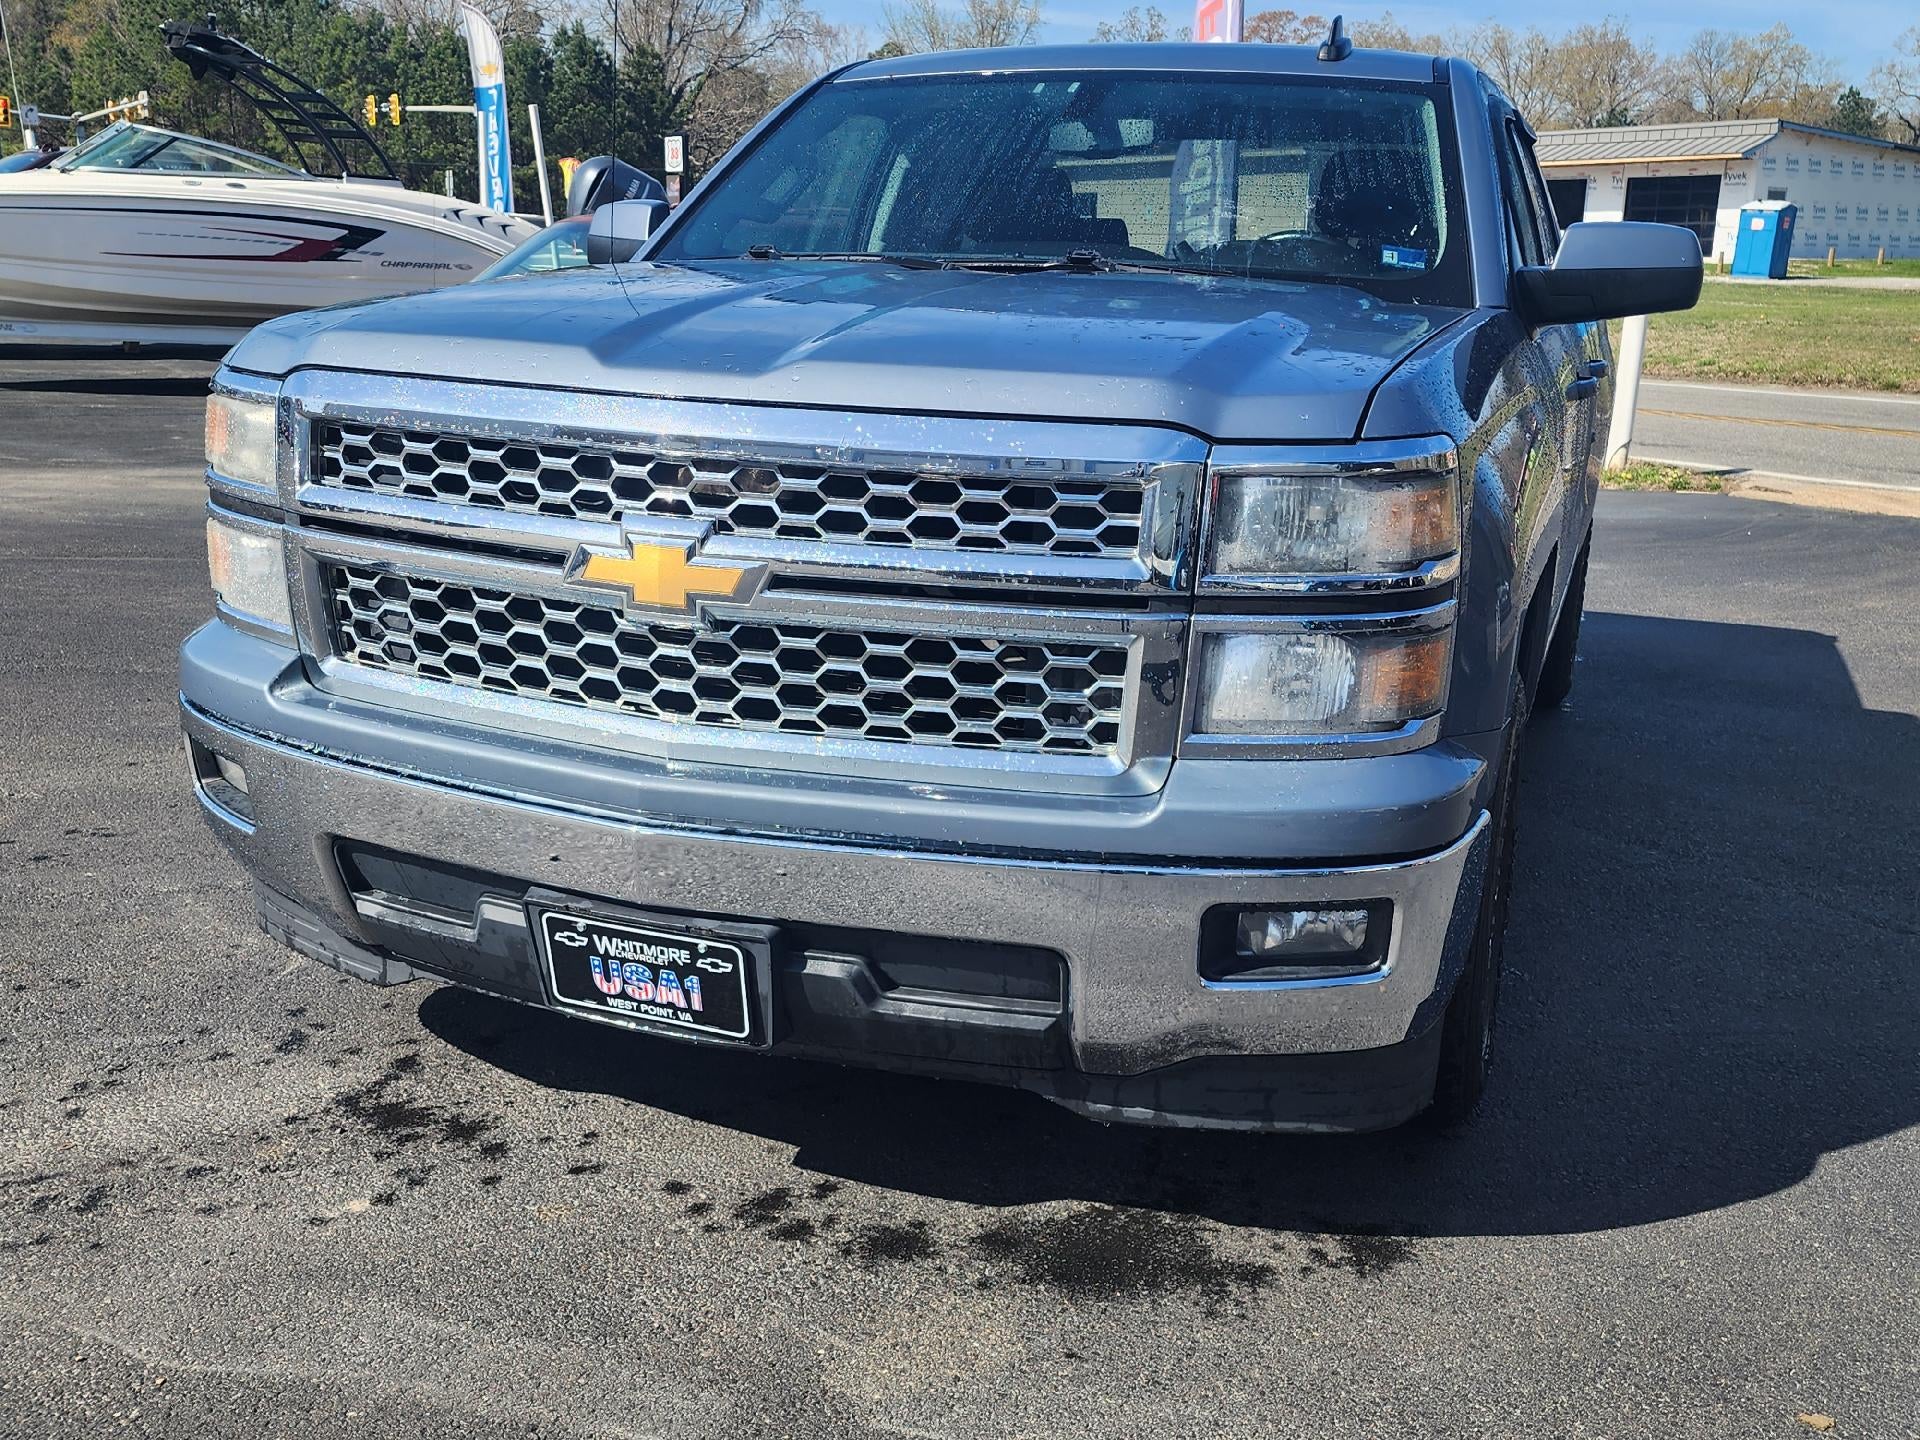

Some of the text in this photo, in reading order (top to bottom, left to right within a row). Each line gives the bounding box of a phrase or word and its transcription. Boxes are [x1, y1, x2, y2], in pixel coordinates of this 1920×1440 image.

[1612, 175, 1623, 185] Tyv
[381, 260, 453, 271] CHAPARRAL
[592, 934, 691, 966] WHITMORE
[616, 950, 668, 966] CHEVROLET
[589, 956, 704, 1012] USA1
[606, 997, 638, 1011] WEST
[677, 1011, 694, 1022] VA
